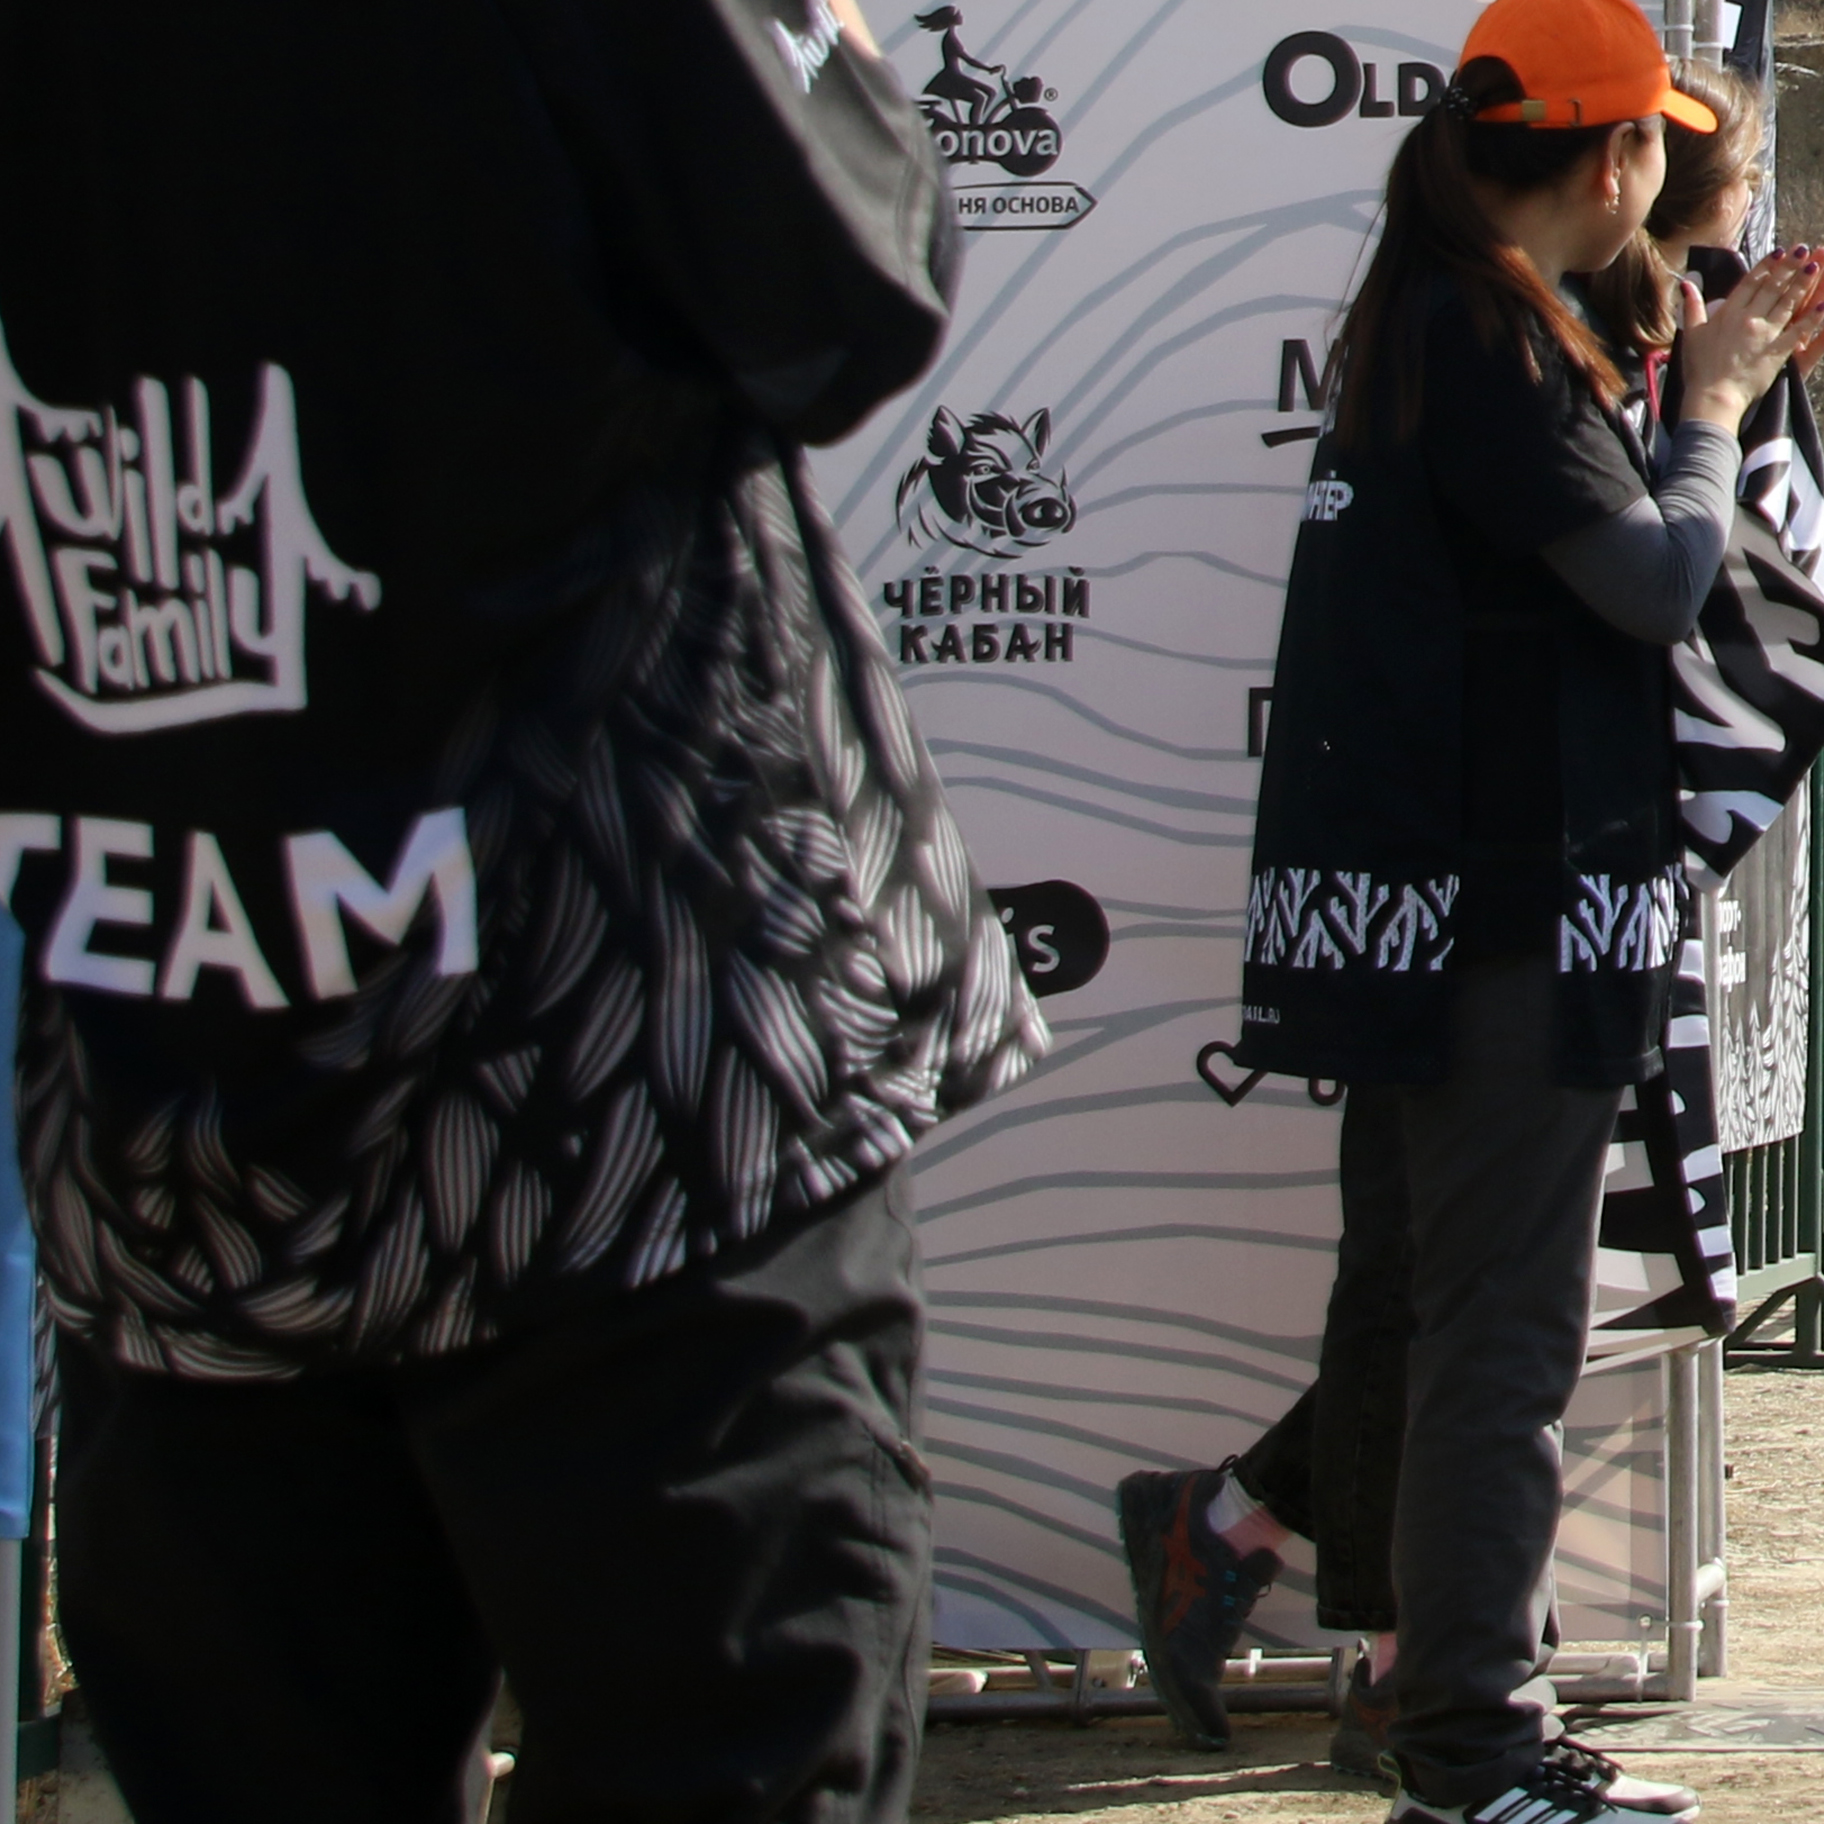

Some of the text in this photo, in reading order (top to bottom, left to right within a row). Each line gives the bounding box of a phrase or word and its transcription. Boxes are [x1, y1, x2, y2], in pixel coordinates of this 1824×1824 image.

[992, 196, 1080, 215] ОСНОВА
[883, 565, 1092, 619] ЧЁРНЫЙ
[54, 546, 308, 696] Family
[899, 622, 1076, 664] КАБАН
[0, 805, 478, 1009] TEAM
